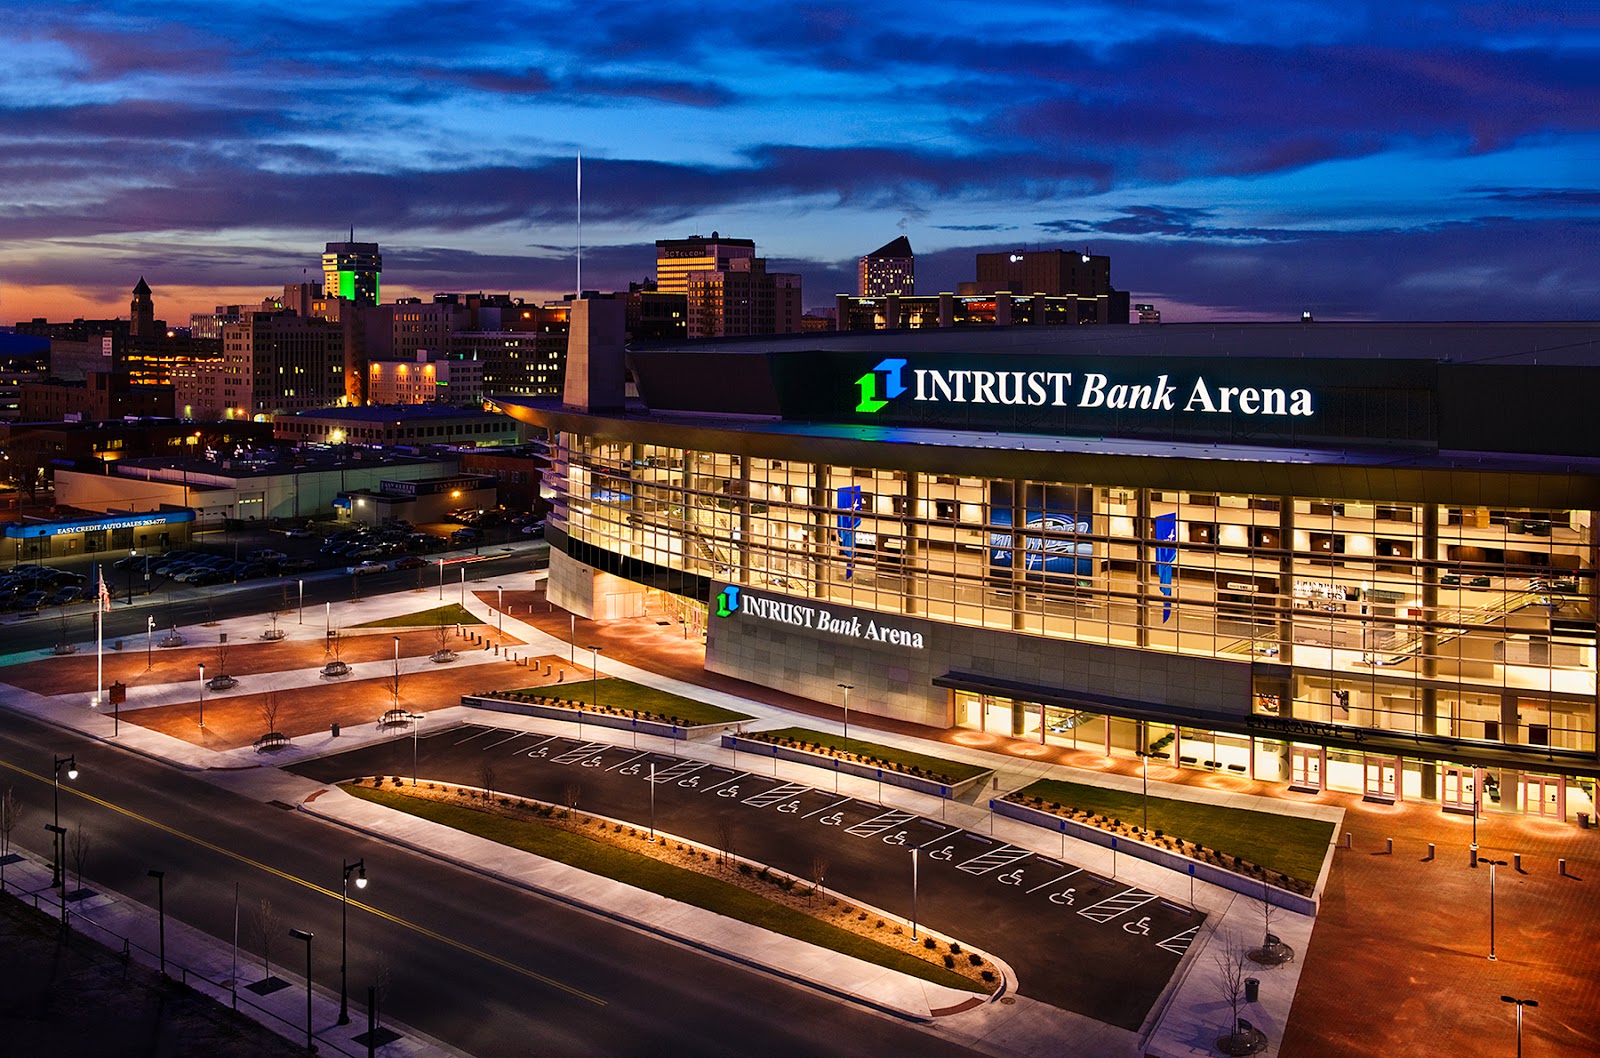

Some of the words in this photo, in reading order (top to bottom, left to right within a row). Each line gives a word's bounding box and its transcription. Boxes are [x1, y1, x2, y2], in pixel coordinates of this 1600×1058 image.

[914, 369, 1071, 406] INTRUST
[1077, 373, 1176, 411] Bank
[1183, 376, 1315, 417] Arena
[122, 520, 142, 528] SALES
[741, 594, 814, 629] INTRUST
[816, 610, 861, 638] Bank
[864, 619, 924, 648] Arena
[1246, 716, 1343, 738] ENTRANCE
[1354, 727, 1367, 742] B
